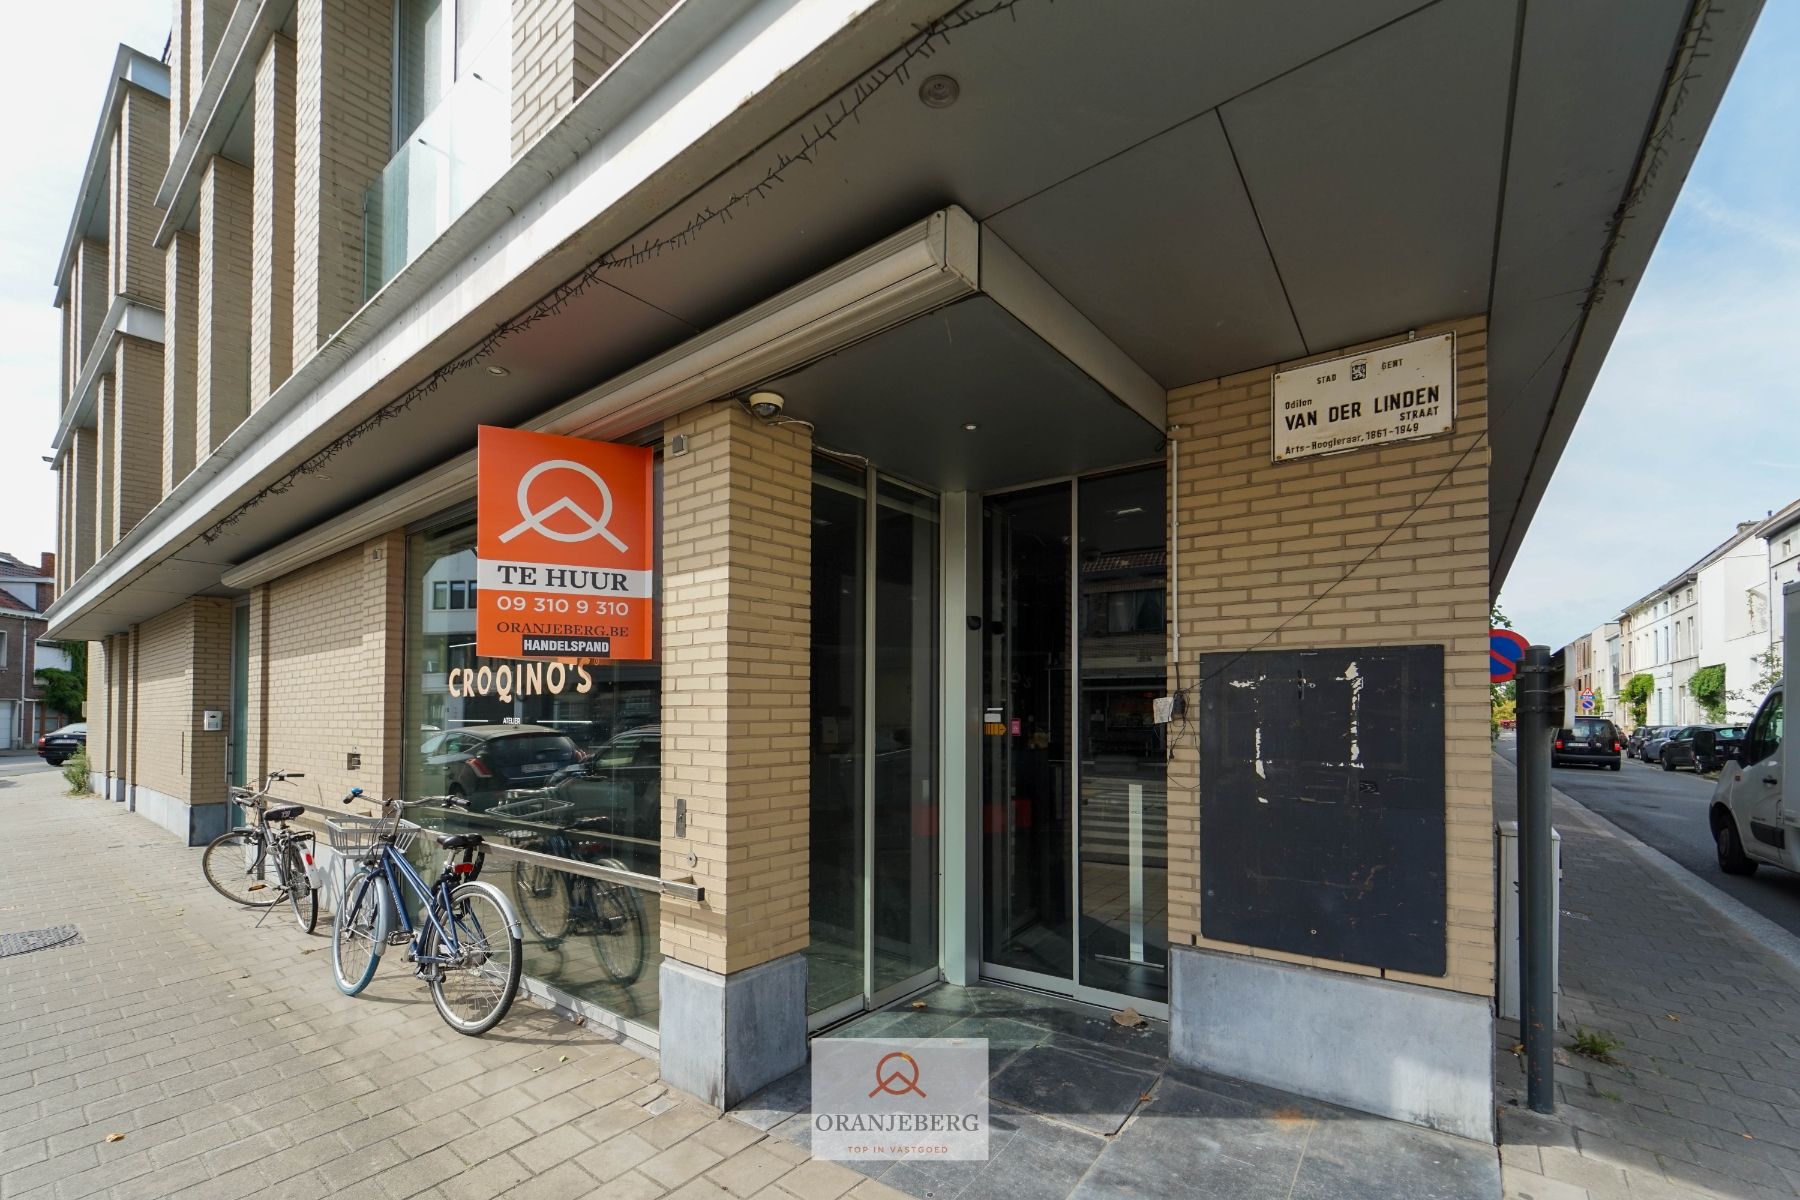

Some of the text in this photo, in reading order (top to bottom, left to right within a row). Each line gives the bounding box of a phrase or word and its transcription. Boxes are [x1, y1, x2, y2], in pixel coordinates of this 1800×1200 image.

[1316, 358, 1404, 385] STAD GENT
[1285, 398, 1313, 410] Odilon
[1285, 385, 1439, 431] VAN DER LINDEN
[1399, 406, 1439, 421] STRAAT
[1366, 422, 1419, 440] 1861-1949
[497, 564, 629, 592] TE HUUR
[497, 595, 629, 616] 09 310 9 310
[496, 620, 629, 638] ORANJEBERG.BE
[523, 638, 610, 653] HANDELSPAND
[448, 657, 593, 703] CROQINO'S
[502, 717, 521, 725] ATELIER
